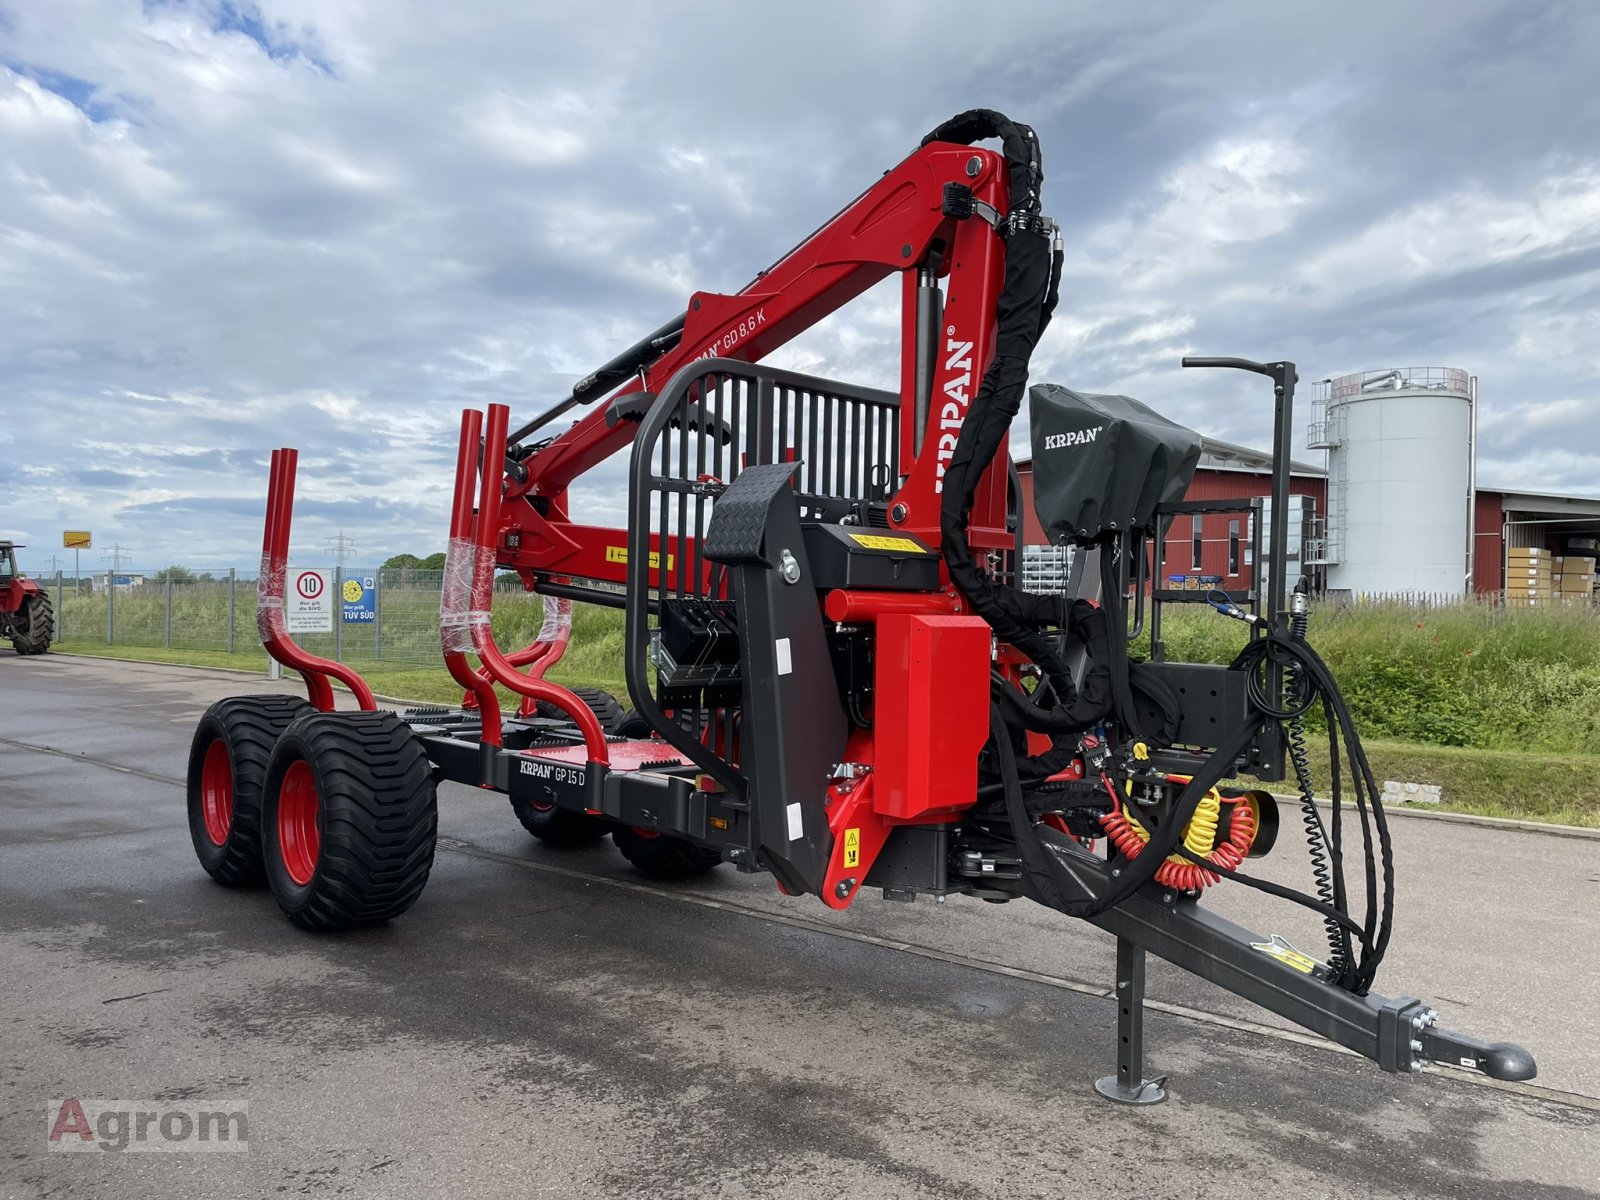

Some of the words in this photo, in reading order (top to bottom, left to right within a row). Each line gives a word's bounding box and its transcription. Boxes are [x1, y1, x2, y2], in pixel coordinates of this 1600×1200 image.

[723, 330, 738, 349] GD
[757, 308, 766, 325] K
[304, 578, 316, 593] 10
[344, 609, 359, 620] TÜV
[360, 609, 375, 620] SÜD
[555, 767, 567, 782] GP
[567, 769, 578, 785] 15
[578, 772, 585, 786] D
